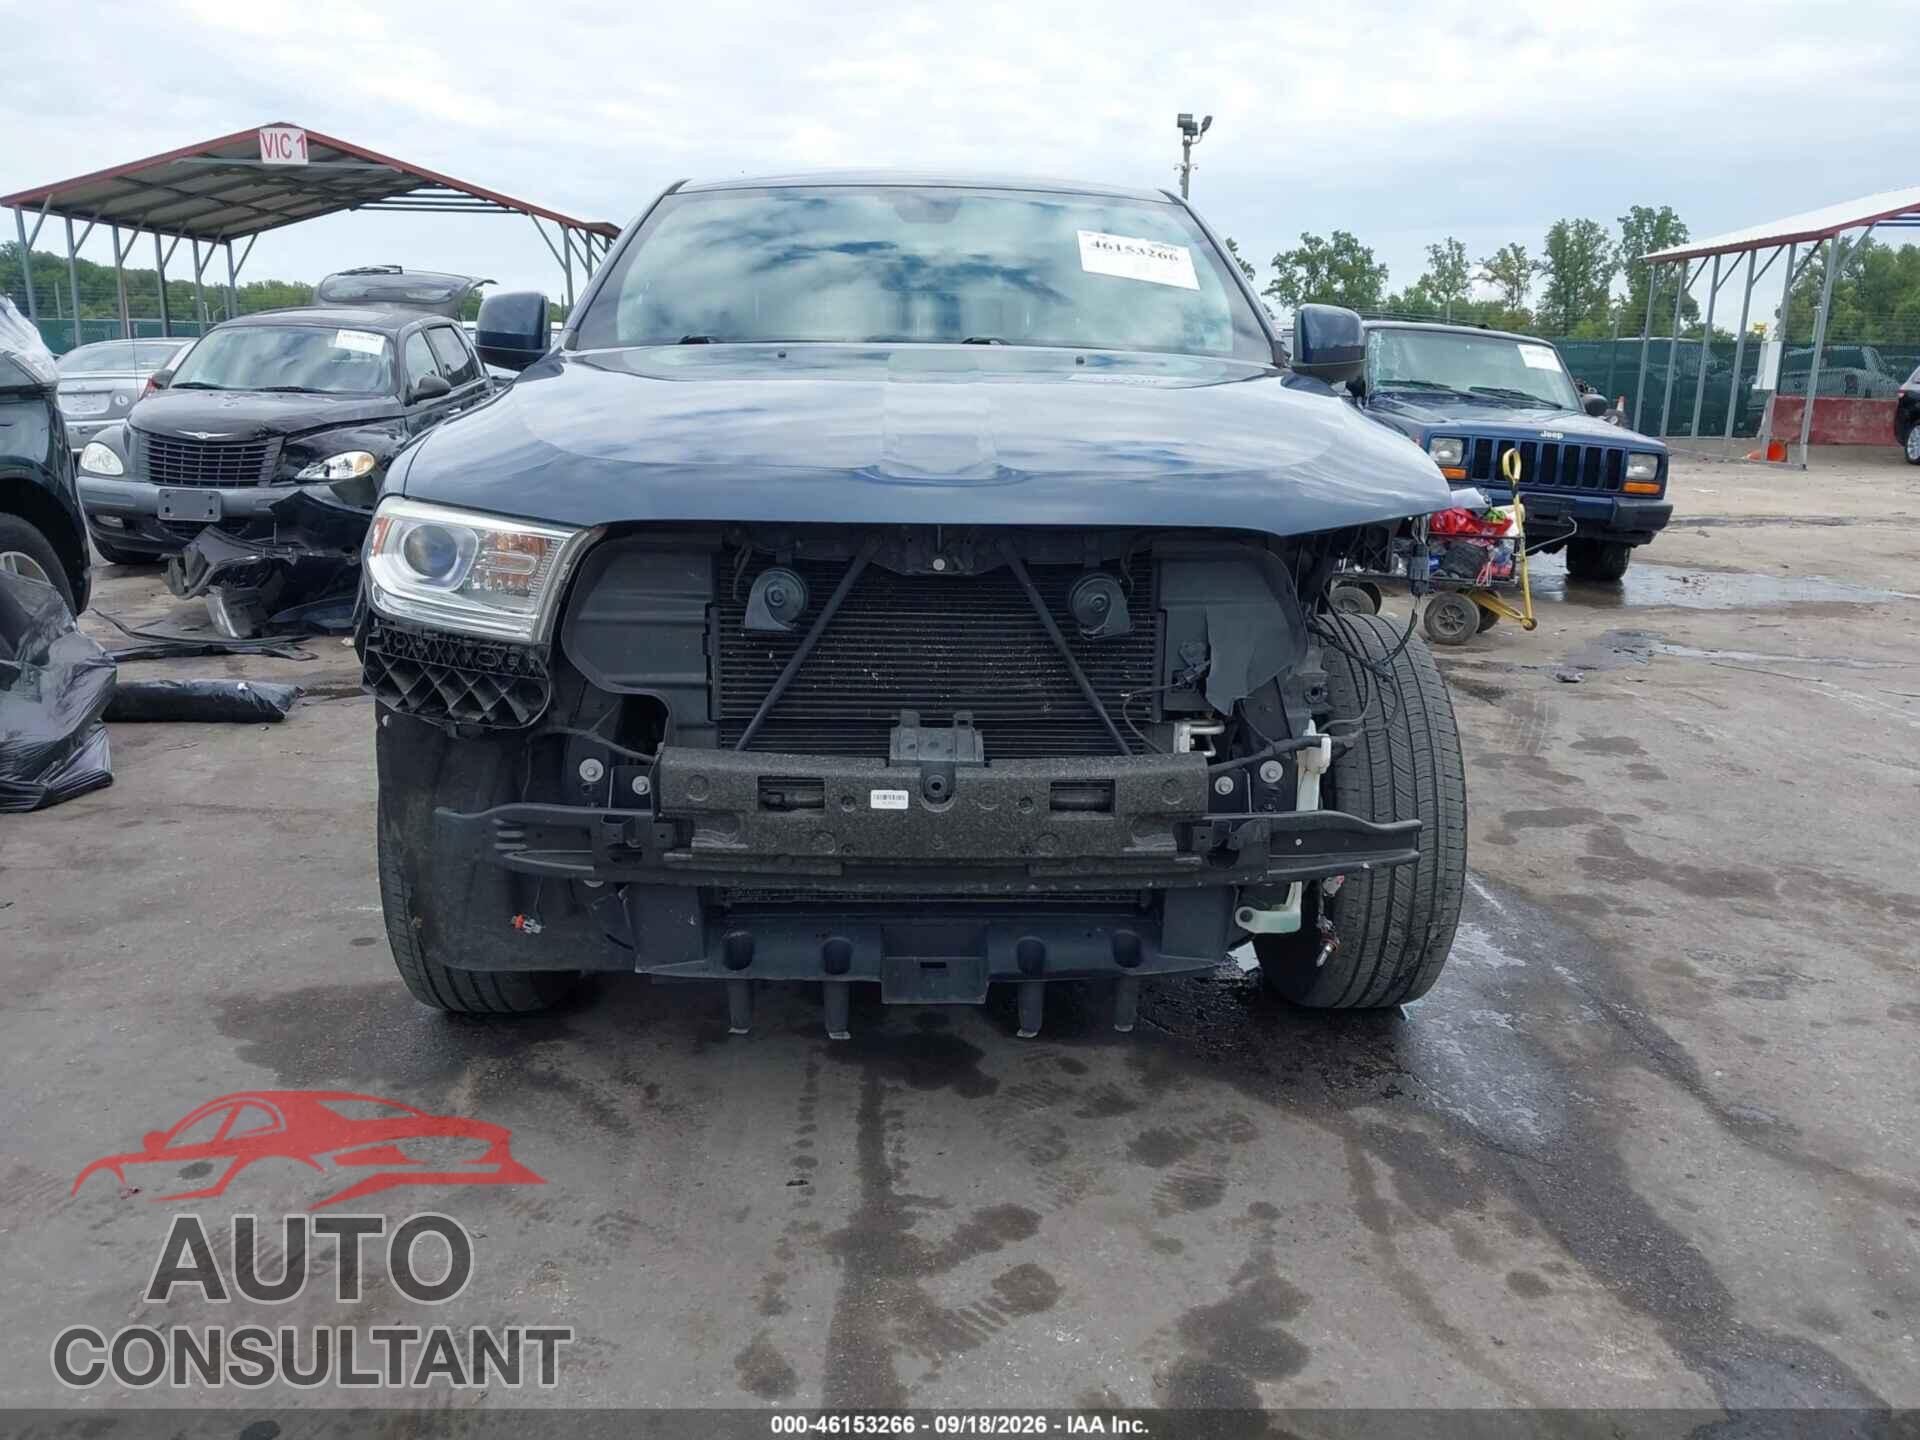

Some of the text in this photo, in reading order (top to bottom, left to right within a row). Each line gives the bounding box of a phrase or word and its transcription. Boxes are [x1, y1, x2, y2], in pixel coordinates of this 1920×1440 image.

[261, 132, 306, 160] VIC 1
[1540, 430, 1564, 440] Jeep
